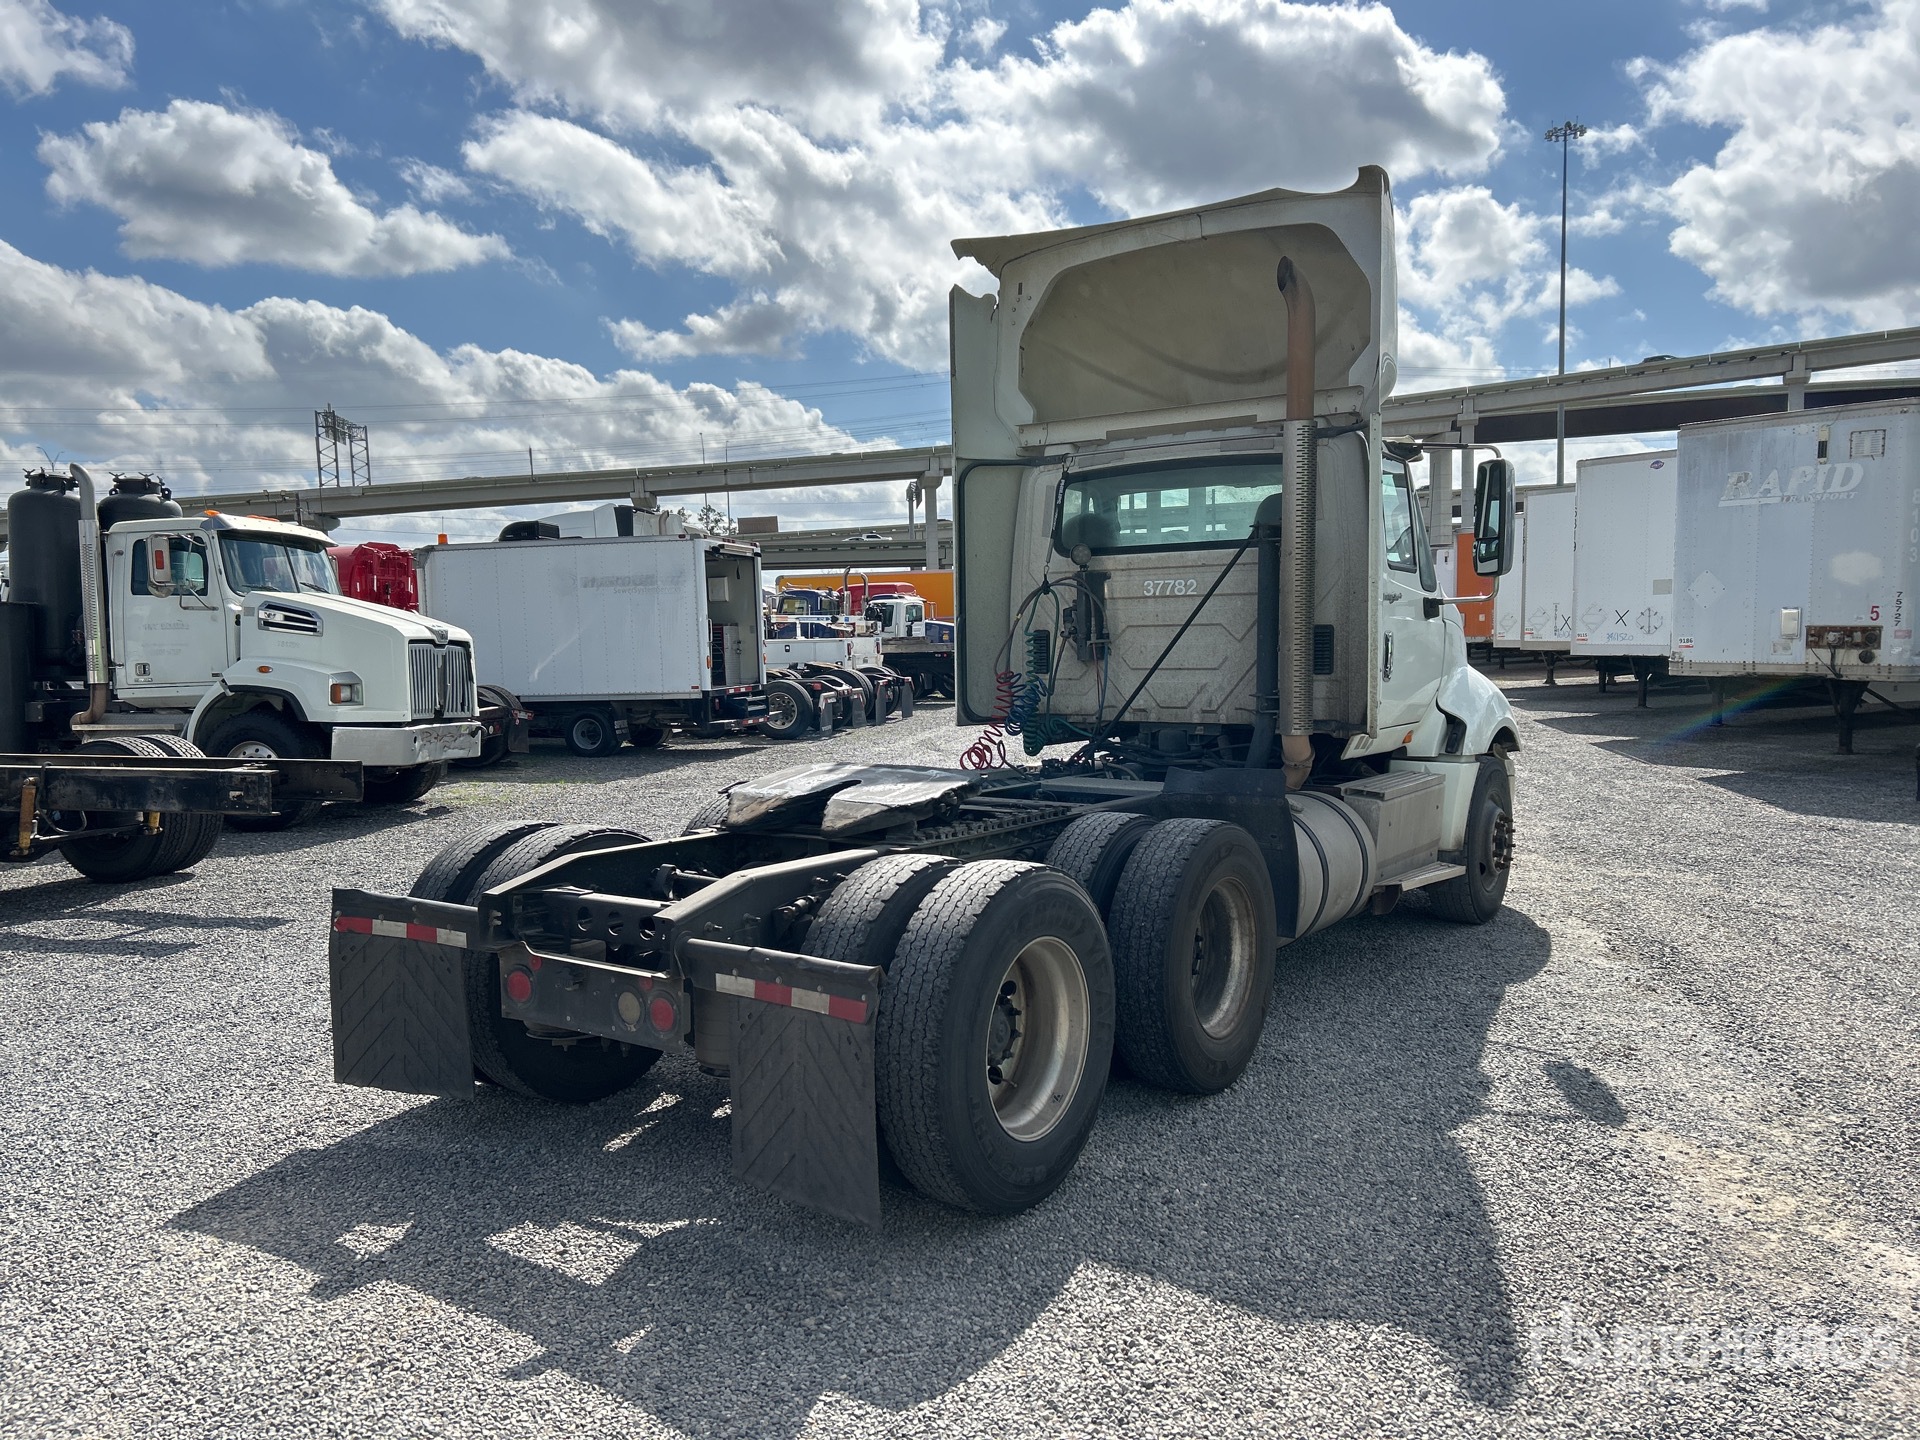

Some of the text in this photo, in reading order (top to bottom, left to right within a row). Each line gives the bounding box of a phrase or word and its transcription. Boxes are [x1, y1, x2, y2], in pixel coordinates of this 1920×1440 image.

[1721, 462, 1864, 500] RAPID
[1781, 491, 1859, 504] TRANSPORT
[1143, 579, 1197, 596] 37782
[1870, 605, 1880, 622] 5
[1894, 591, 1903, 627] 75727
